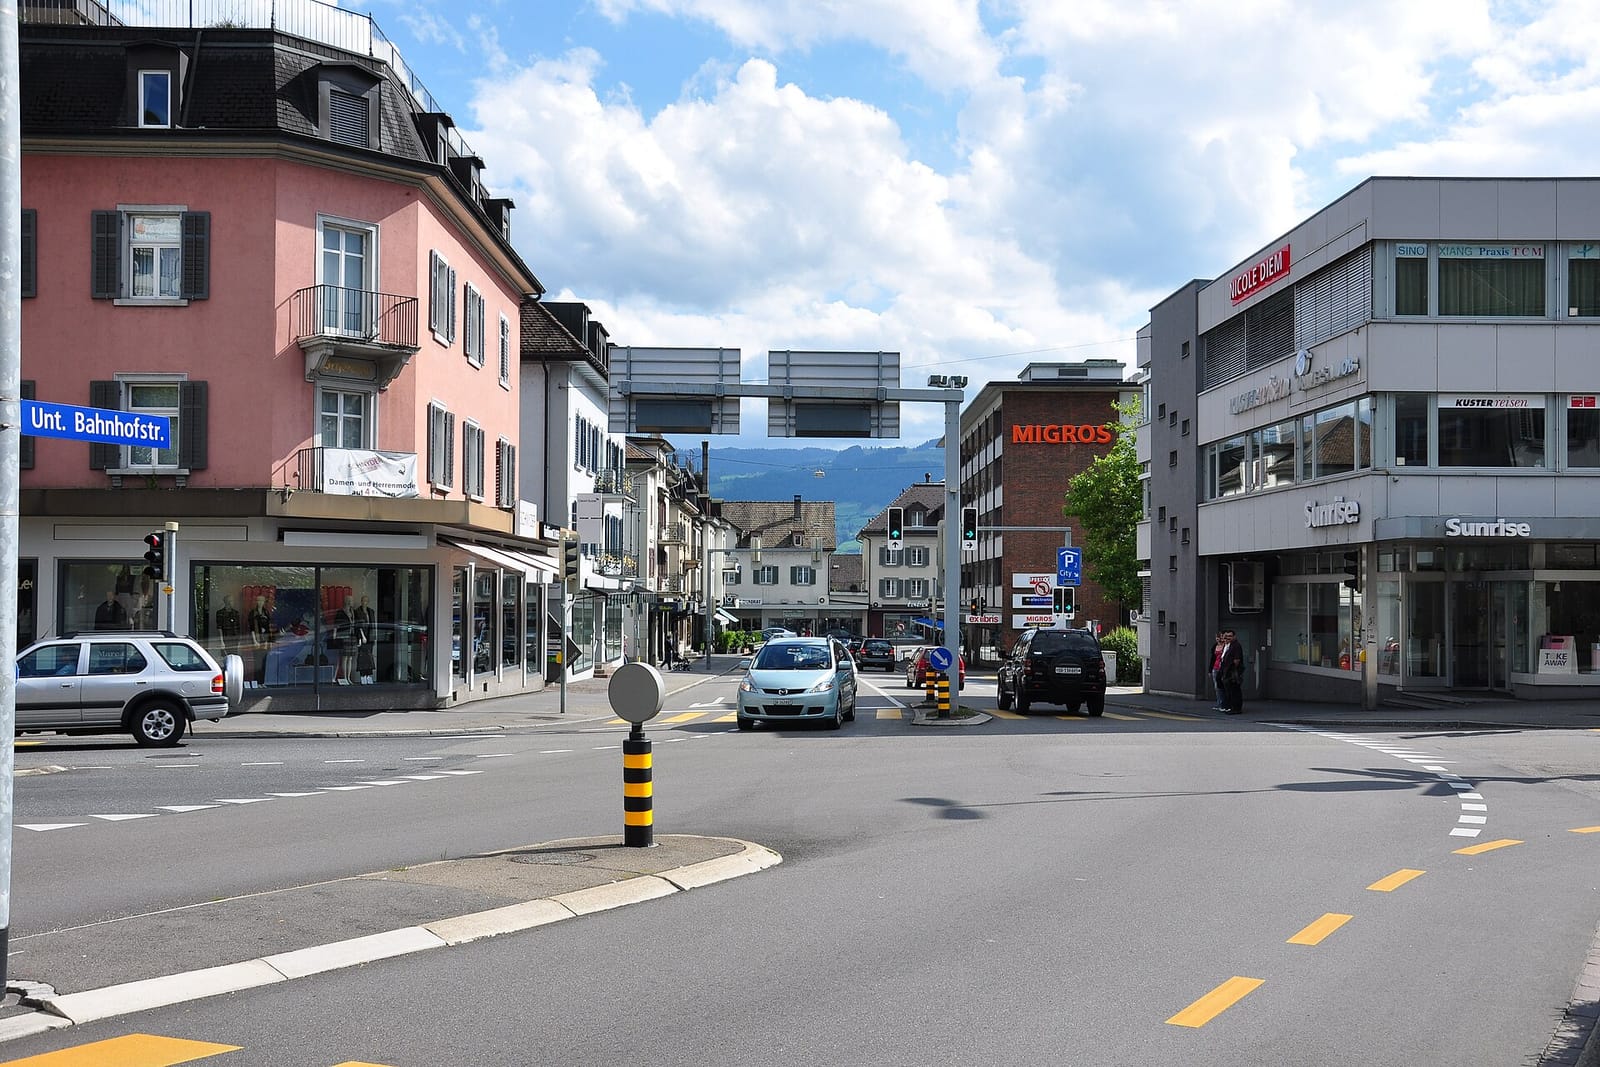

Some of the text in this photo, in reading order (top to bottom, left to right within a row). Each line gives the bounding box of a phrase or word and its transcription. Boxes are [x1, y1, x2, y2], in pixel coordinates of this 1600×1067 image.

[1398, 245, 1425, 256] SINO
[1439, 246, 1473, 256] XIANG
[1479, 247, 1509, 256] Praxis
[1229, 251, 1283, 299] NICOLE DIEM
[31, 406, 164, 441] Unt. Bahnhofstr.
[1012, 424, 1112, 444] MIGROS
[372, 481, 416, 489] Herrenmode
[1304, 496, 1360, 529] Sunrise
[1445, 518, 1532, 537] Sunrise
[1065, 555, 1073, 567] P
[1060, 570, 1072, 578] City
